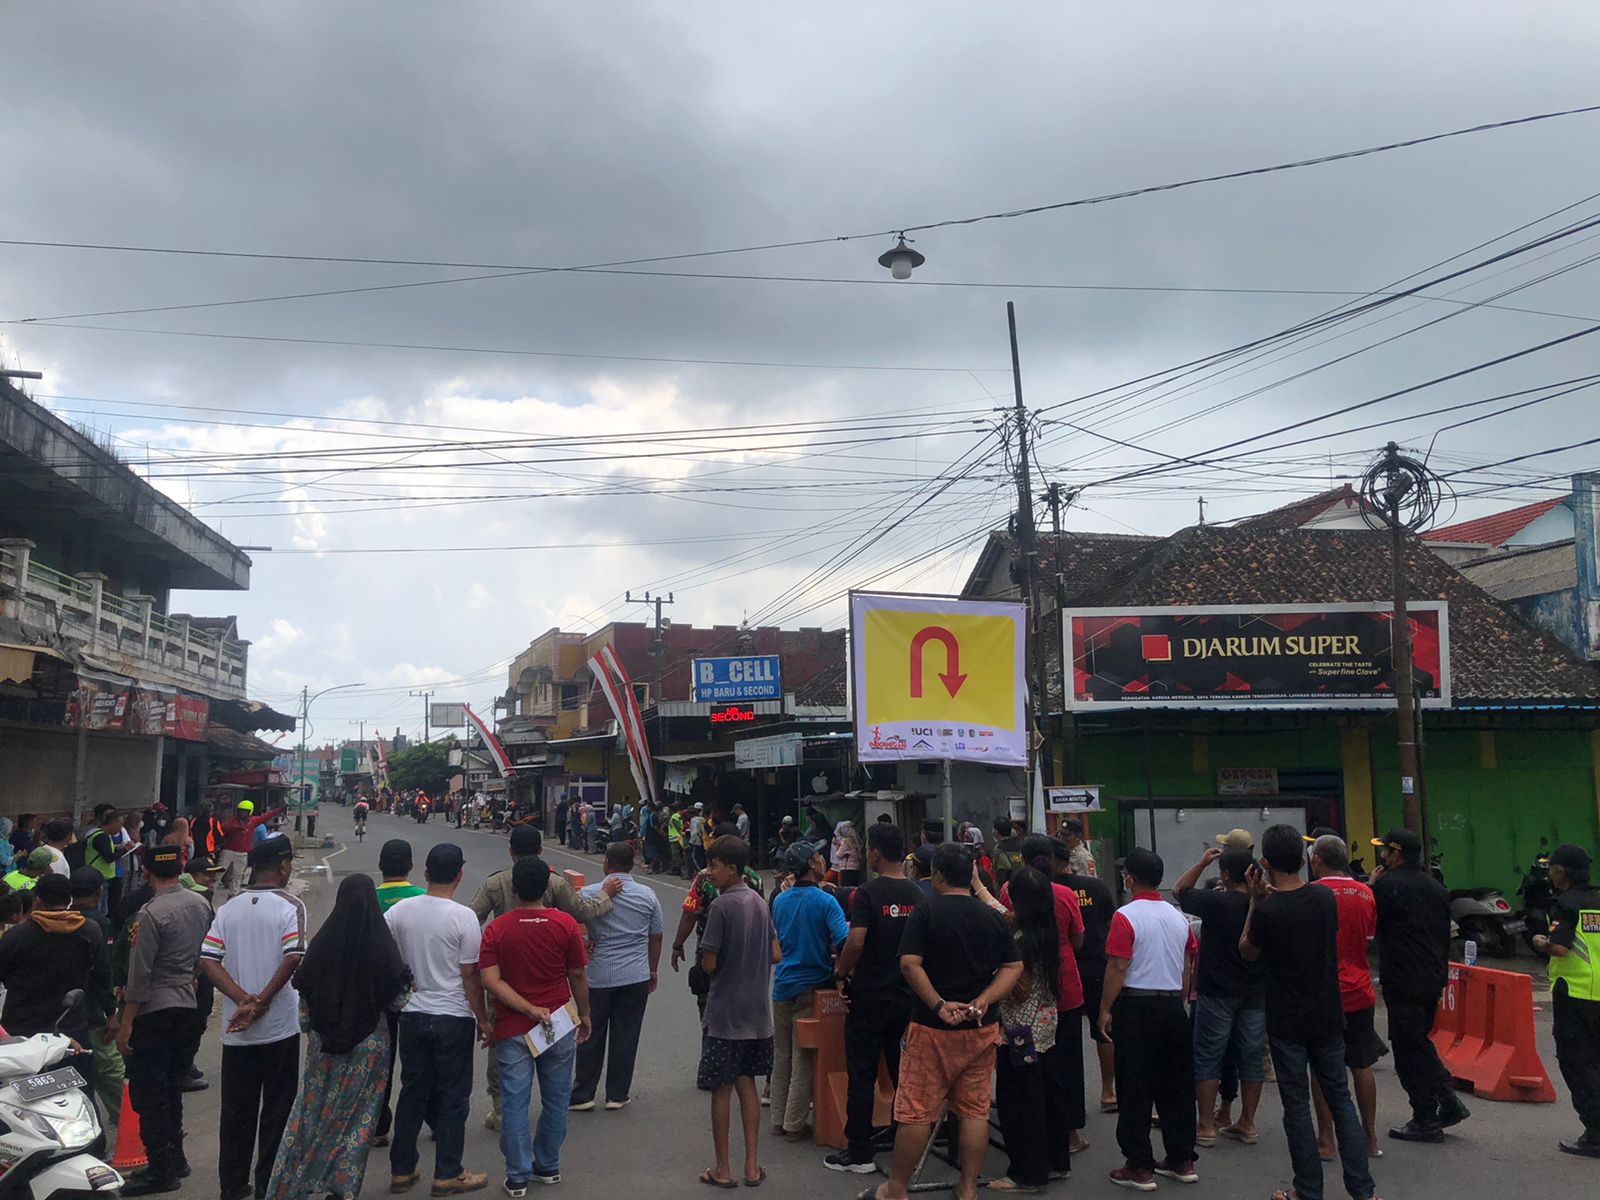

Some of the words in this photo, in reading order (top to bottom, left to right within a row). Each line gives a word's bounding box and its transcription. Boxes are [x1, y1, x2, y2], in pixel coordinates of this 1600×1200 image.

[1183, 637, 1281, 659] DJARUM
[1285, 636, 1362, 655] SUPER
[1318, 667, 1355, 676] Superfine
[701, 688, 712, 698] HP
[714, 687, 735, 697] BARU
[736, 687, 743, 695] &
[744, 685, 775, 695] SECOND
[711, 711, 754, 722] SECOND
[27, 1074, 56, 1087] 5869
